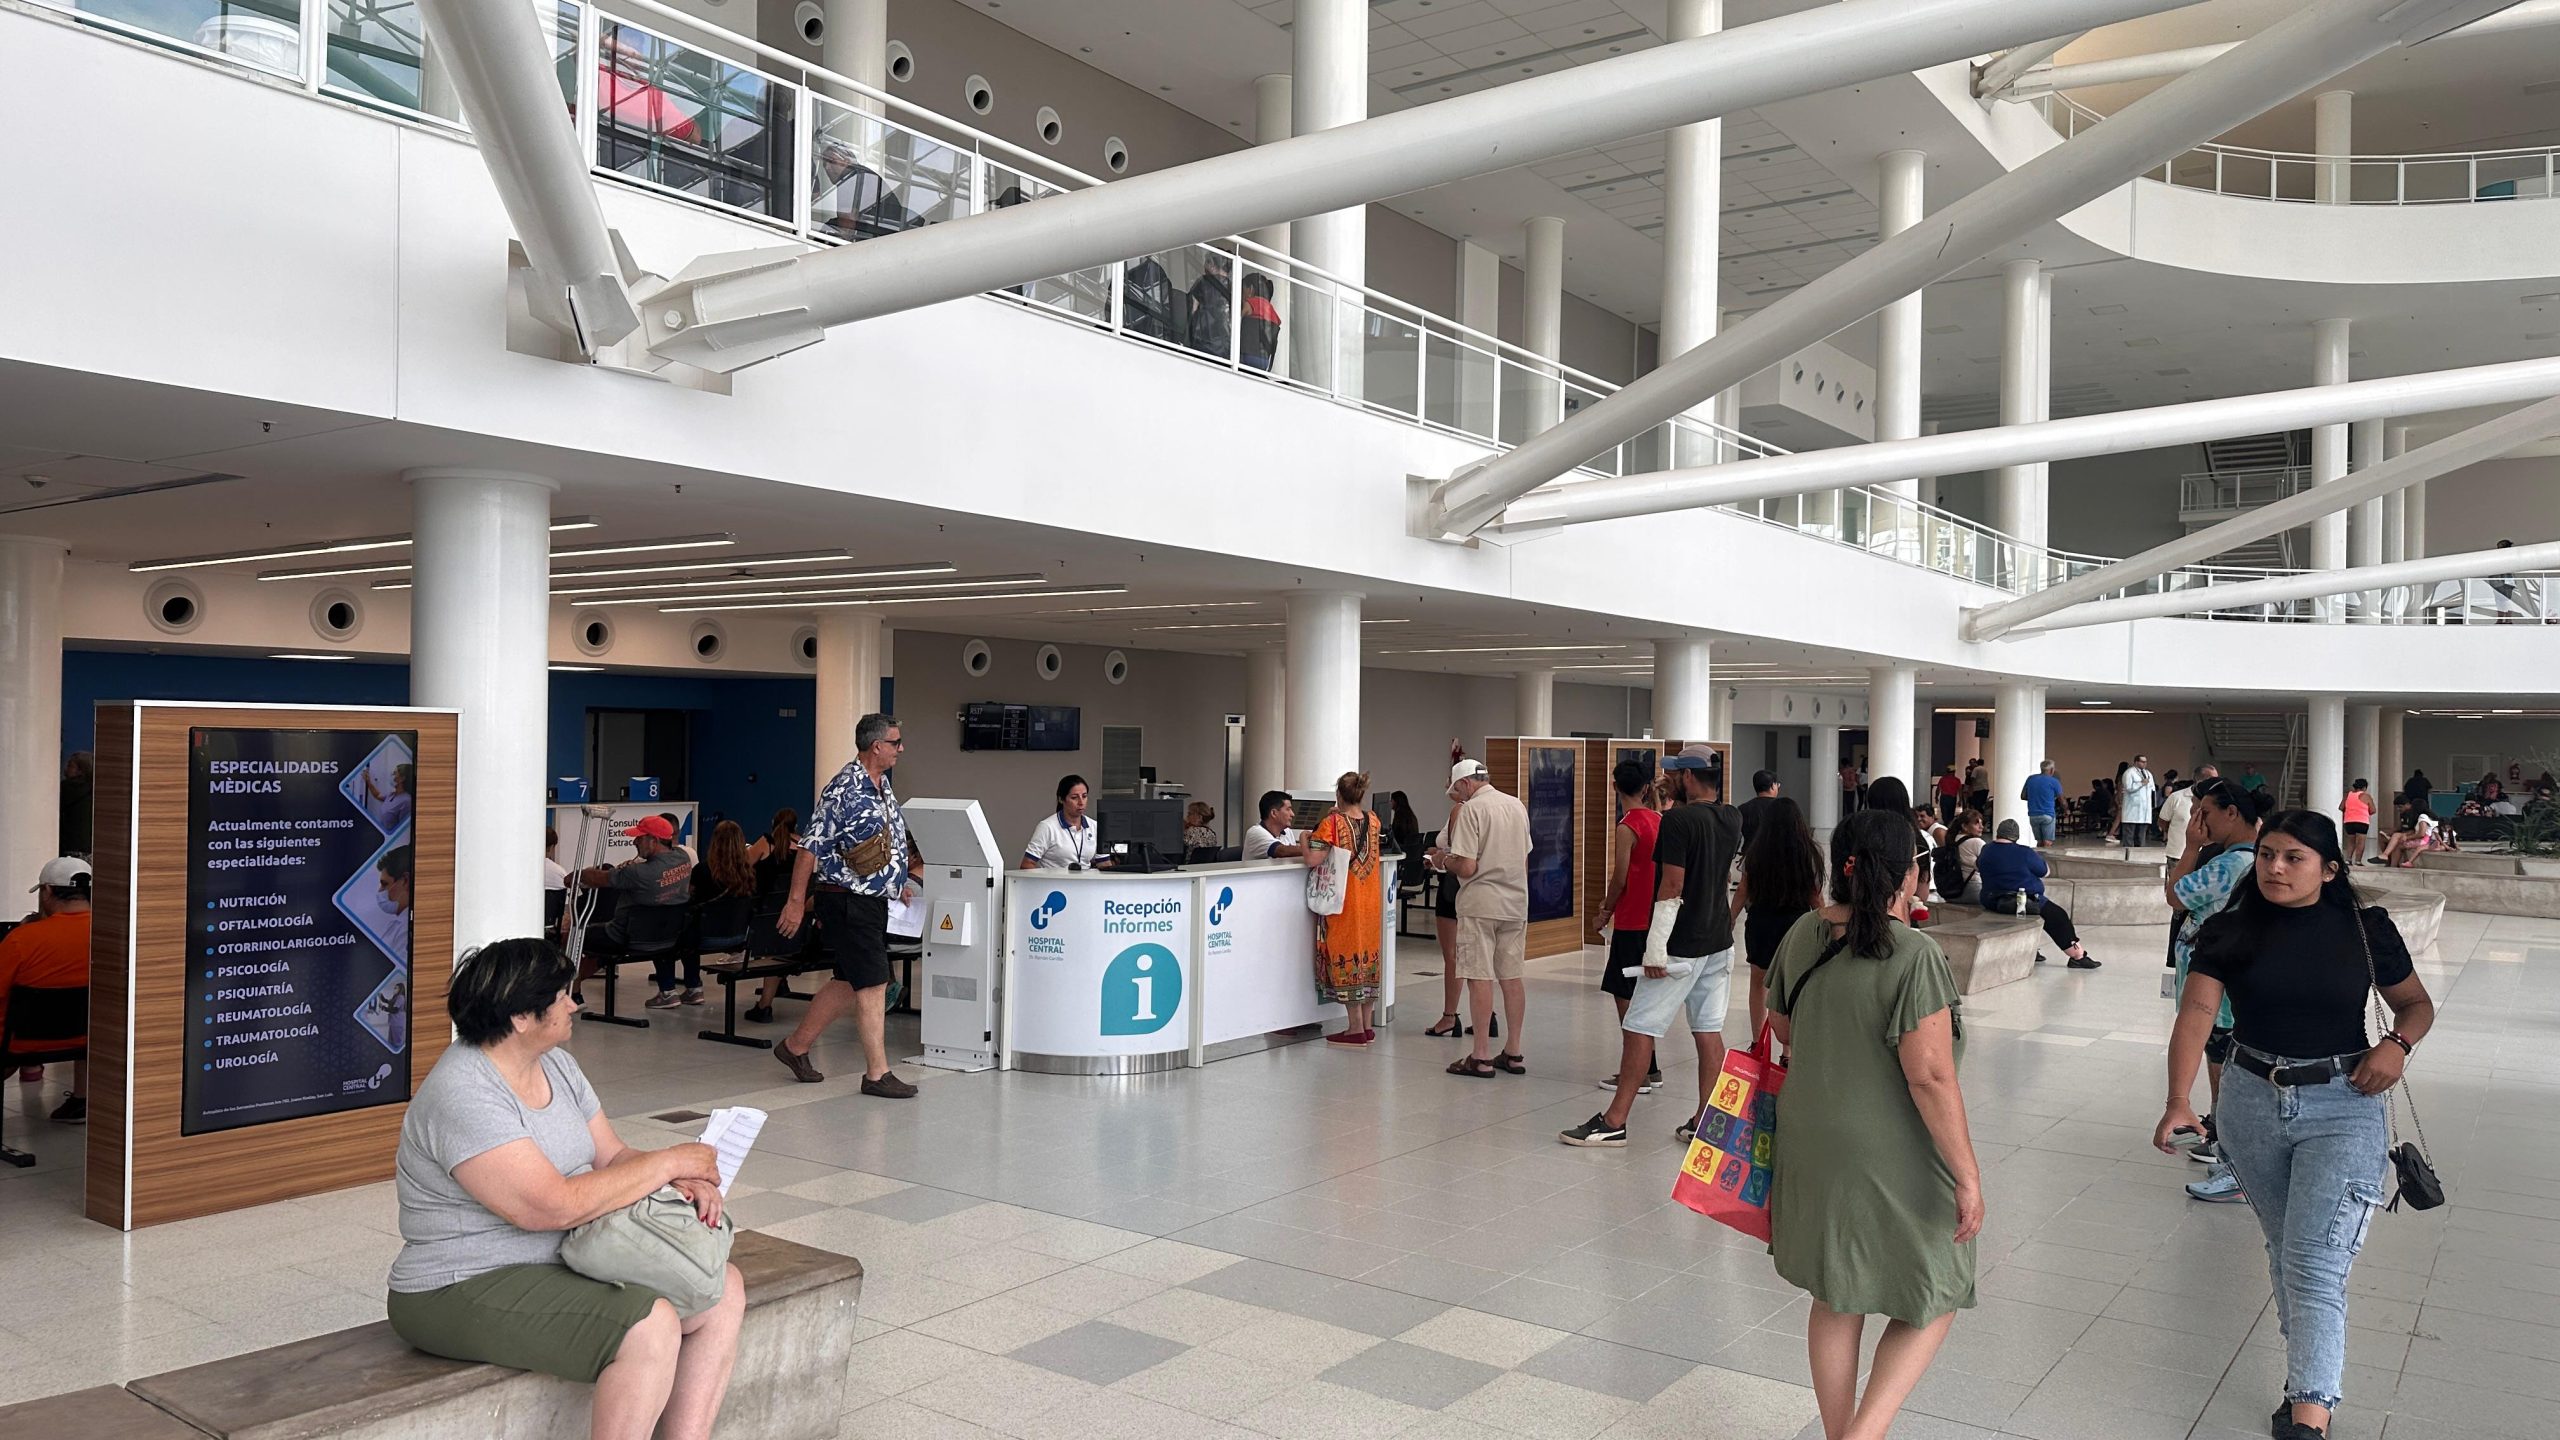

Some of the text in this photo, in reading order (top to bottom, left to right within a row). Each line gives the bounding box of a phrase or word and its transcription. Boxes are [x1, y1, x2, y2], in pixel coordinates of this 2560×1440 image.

[210, 760, 339, 774] ESPECIALIDADES
[579, 784, 588, 798] 7
[649, 784, 658, 797] 8
[208, 818, 354, 832] Actualmente contamos
[208, 836, 321, 850] con las siguientes
[207, 855, 306, 870] especialidades:
[219, 893, 287, 909] NUTRICIÓN
[1104, 898, 1181, 918] Recepción
[218, 913, 314, 932] OFTALMOLOGÍA
[1103, 918, 1173, 934] Informes
[217, 932, 357, 954] OTORRINOLARIGOLOGÍA
[1028, 936, 1065, 946] HOSPITAL
[1207, 931, 1232, 941] HOSPITAL
[1029, 945, 1064, 954] CENTRAL
[1208, 939, 1232, 949] CENTRAL
[217, 960, 290, 977] PSICOLOGÍA
[217, 982, 294, 1000] PSIQUIATRÍA
[216, 1002, 312, 1024] REUMATOLOGÍA
[216, 1025, 319, 1046] TRAUMATOLOGÍA
[215, 1051, 279, 1069] UROLOGÍA
[342, 1078, 368, 1086] HOSPITAL
